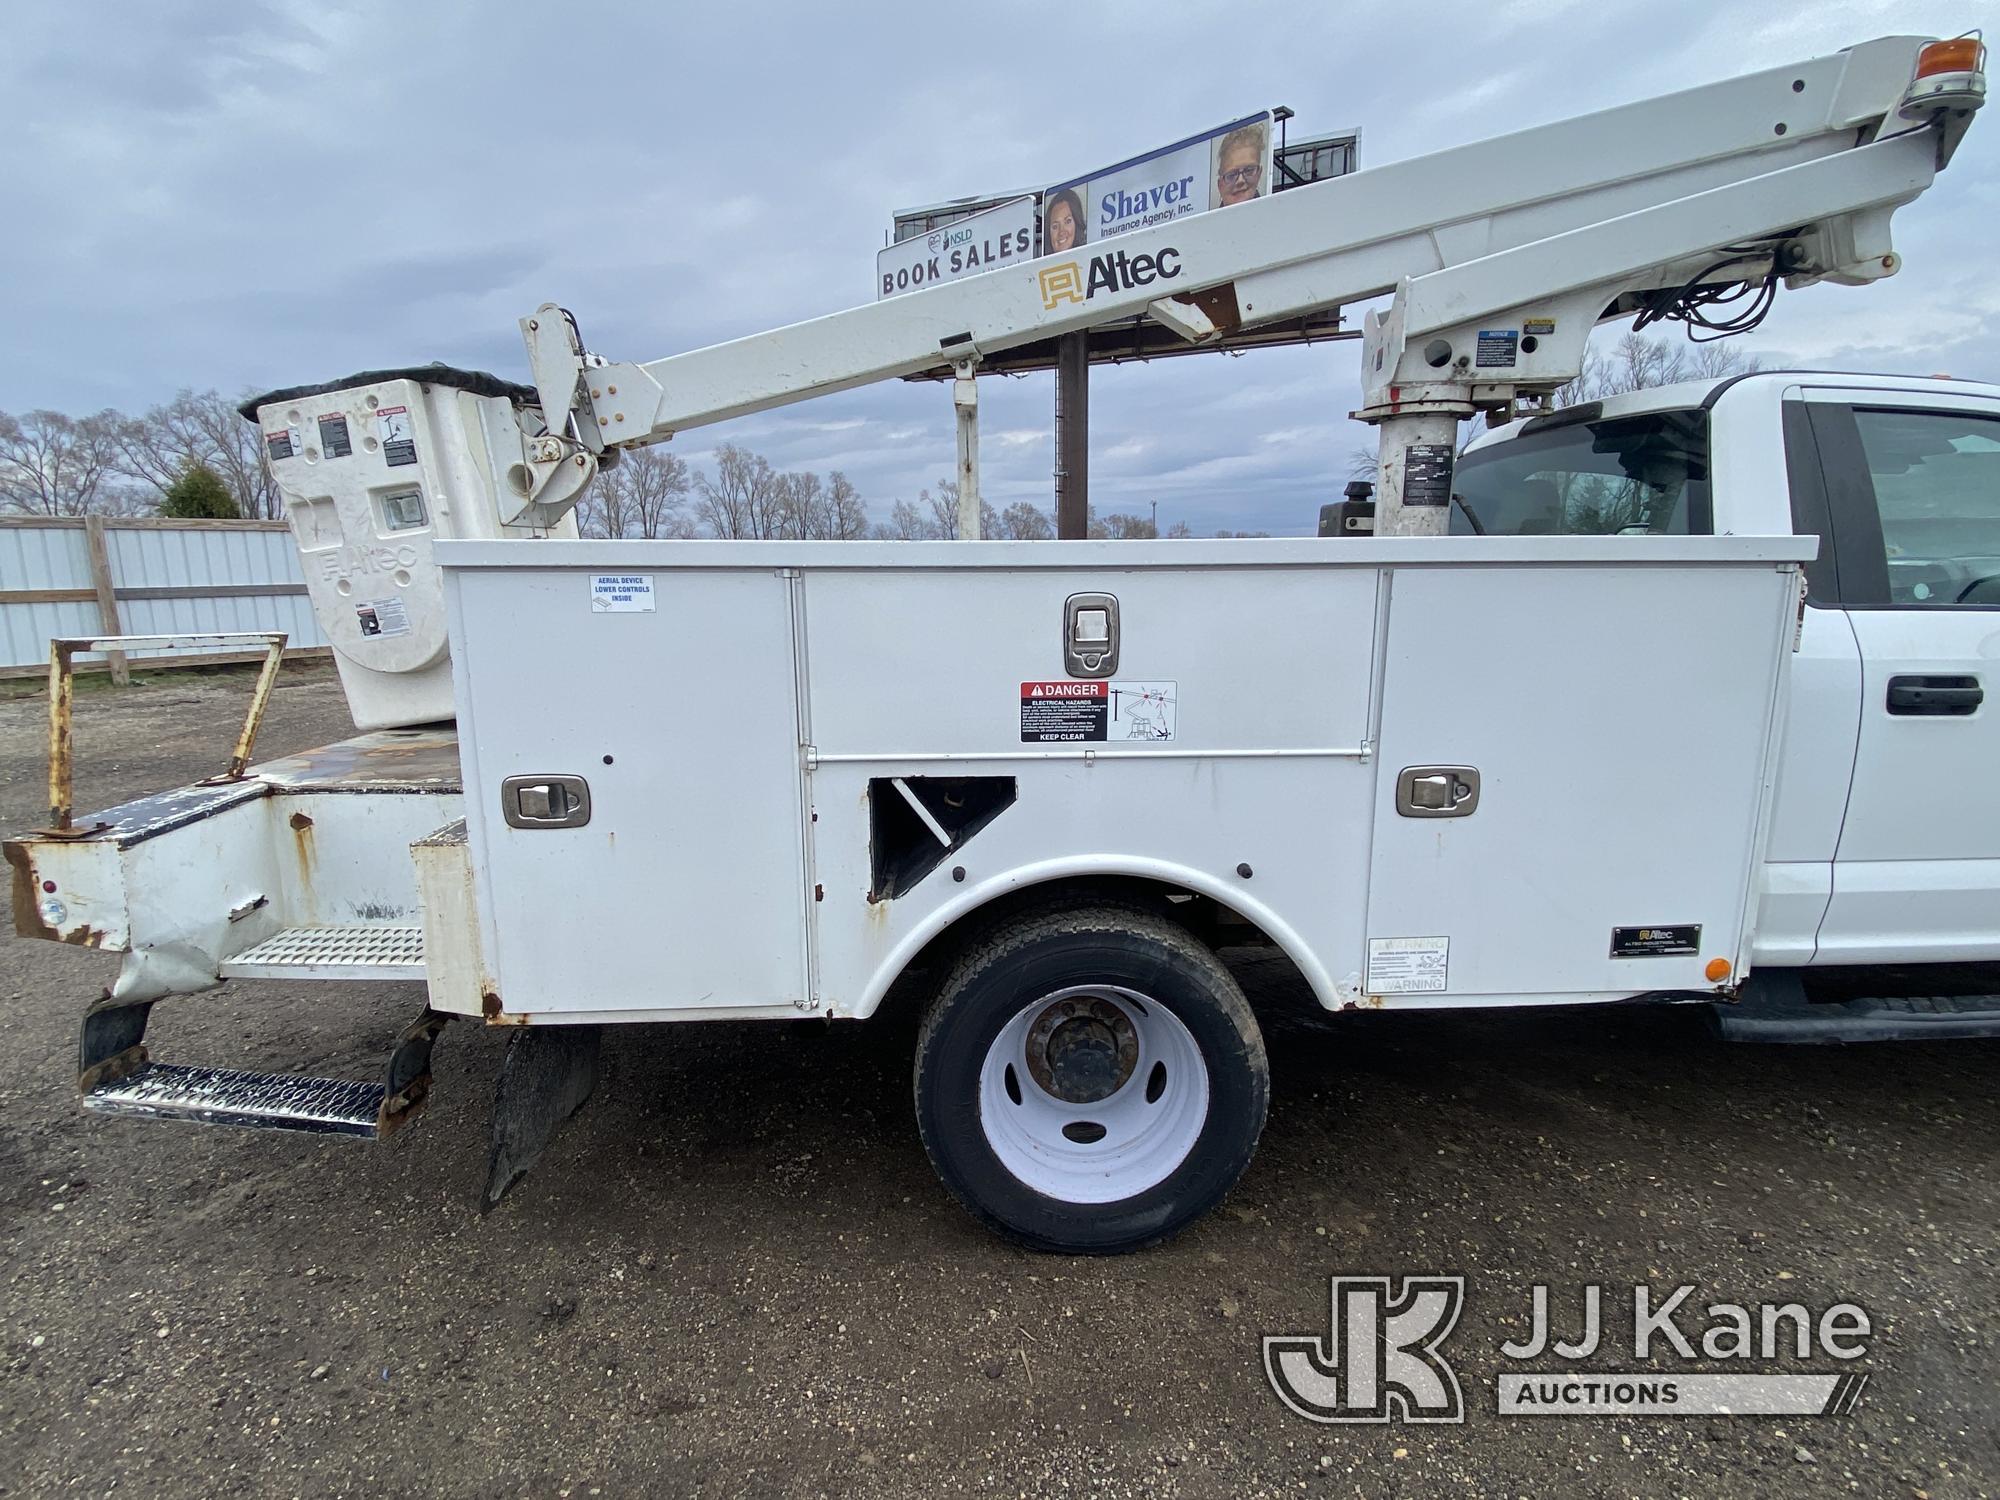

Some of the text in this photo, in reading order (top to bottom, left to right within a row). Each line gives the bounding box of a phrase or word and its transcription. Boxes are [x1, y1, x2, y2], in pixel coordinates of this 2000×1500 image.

[1101, 176, 1194, 225] Shaver
[951, 229, 973, 246] NSLD
[1100, 202, 1194, 238] Insurance Agency, Inc.
[883, 228, 1030, 294] BOOK SALES
[1085, 248, 1182, 300] Altec
[1045, 684, 1099, 696] DANGER
[1040, 733, 1060, 741] KEEP
